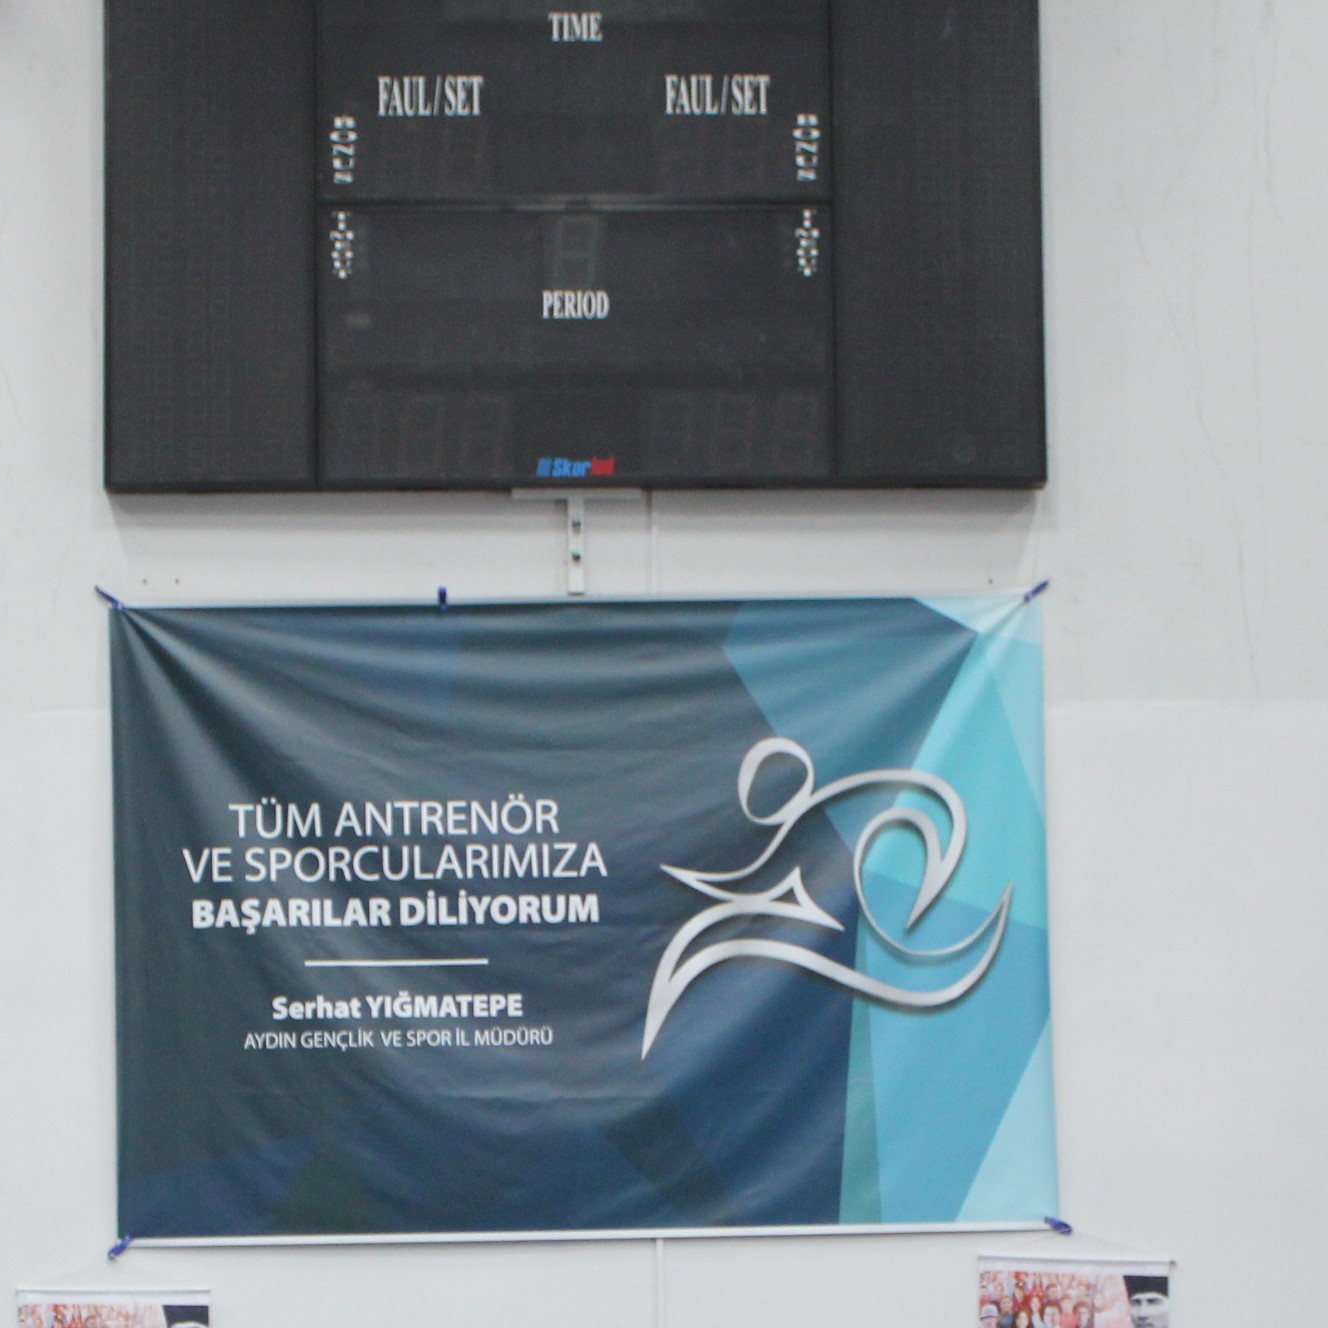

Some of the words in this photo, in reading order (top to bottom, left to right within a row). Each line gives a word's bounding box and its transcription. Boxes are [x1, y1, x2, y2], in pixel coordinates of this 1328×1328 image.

[548, 11, 603, 41] TIME
[378, 75, 483, 116] FAUL/SET
[665, 74, 770, 115] FAUL/SET
[542, 291, 610, 319] PERIOD
[229, 797, 322, 838] TÜM
[335, 795, 559, 836] ANTRENÖR
[183, 848, 232, 883] VE
[244, 843, 608, 882] SPORCULARIMIZA
[192, 898, 390, 934] BAŞARILAR
[400, 889, 599, 925] DİLİYORUM
[272, 996, 360, 1021] Serhat
[365, 990, 523, 1019] YIĞMATEPE
[244, 1032, 296, 1050] AYDIN
[301, 1028, 373, 1051] GENÇLİK
[381, 1031, 403, 1048] VE
[407, 1030, 452, 1047] SPOR
[455, 1026, 470, 1046] İL
[475, 1026, 553, 1047] MÜDÜRÜ
